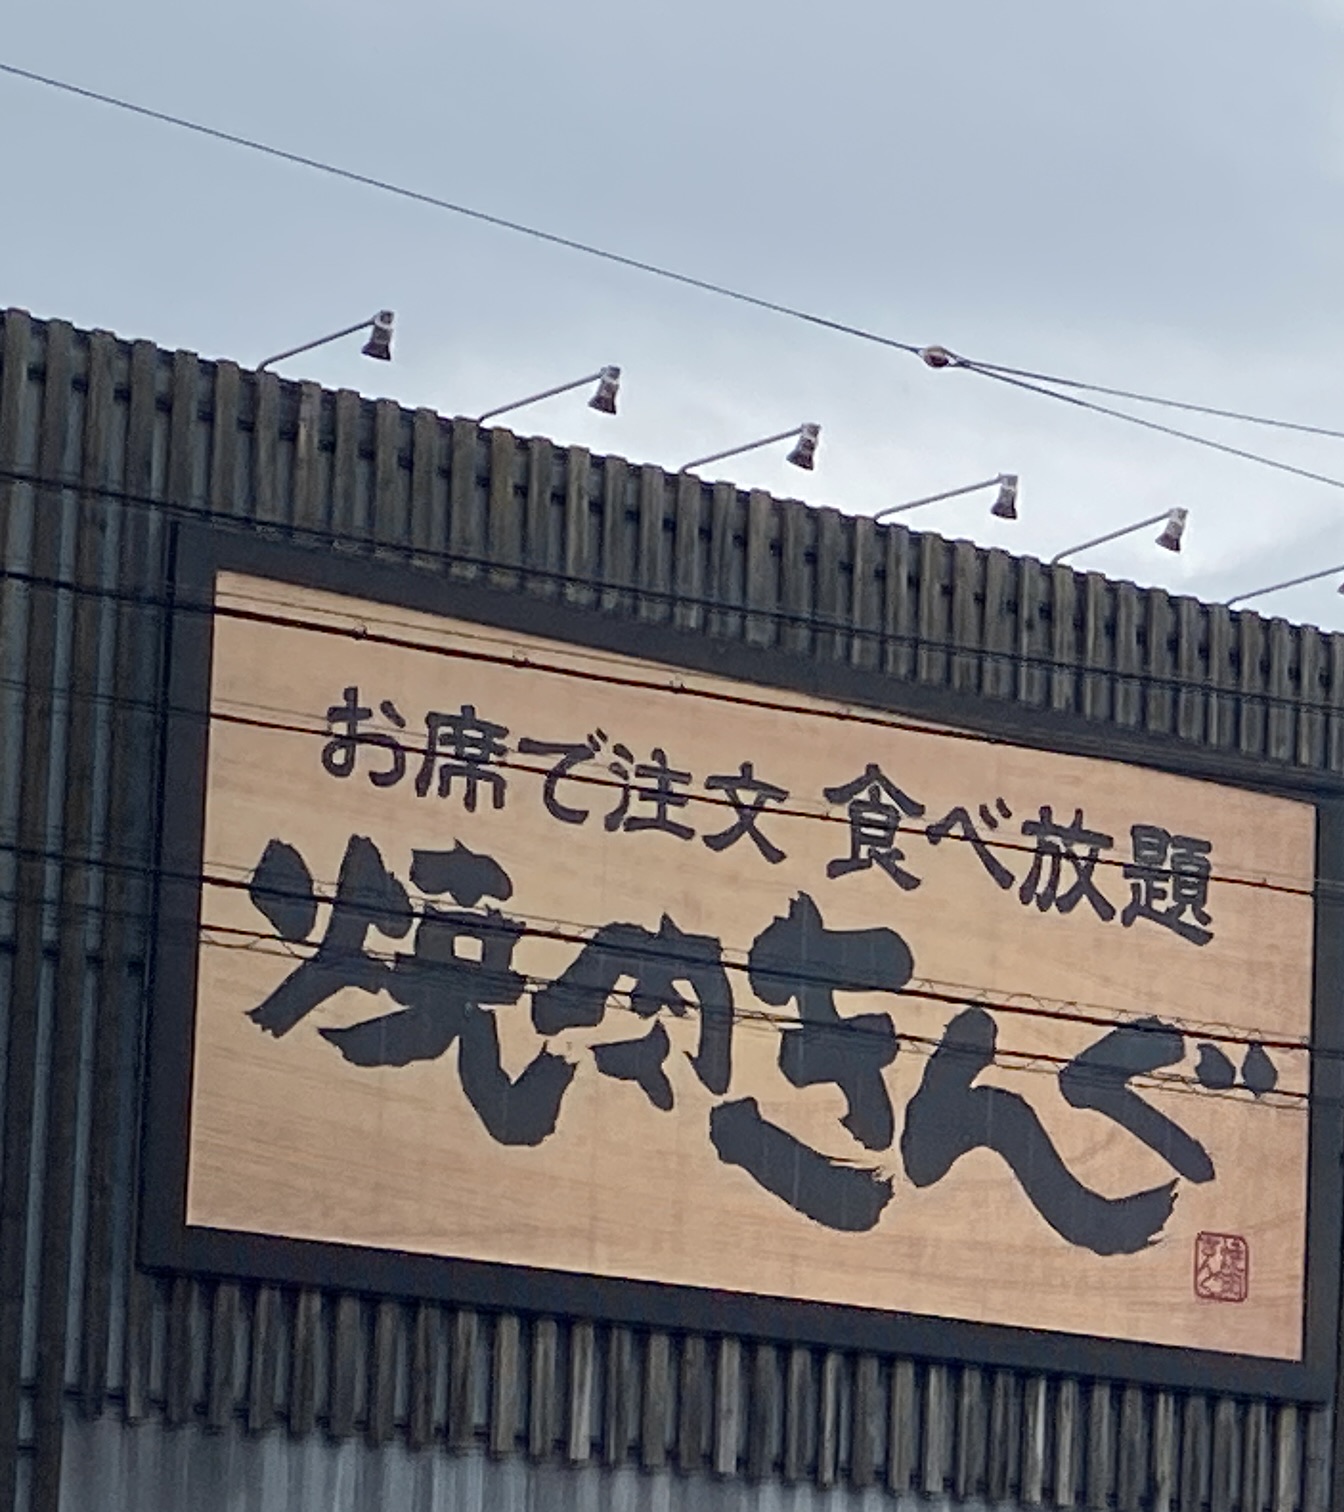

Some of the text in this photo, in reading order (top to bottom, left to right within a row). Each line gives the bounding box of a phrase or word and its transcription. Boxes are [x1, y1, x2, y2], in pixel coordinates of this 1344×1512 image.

[321, 685, 1215, 946] お席で注文 食べ放題
[246, 835, 1279, 1257] 焼肉きんぐ
